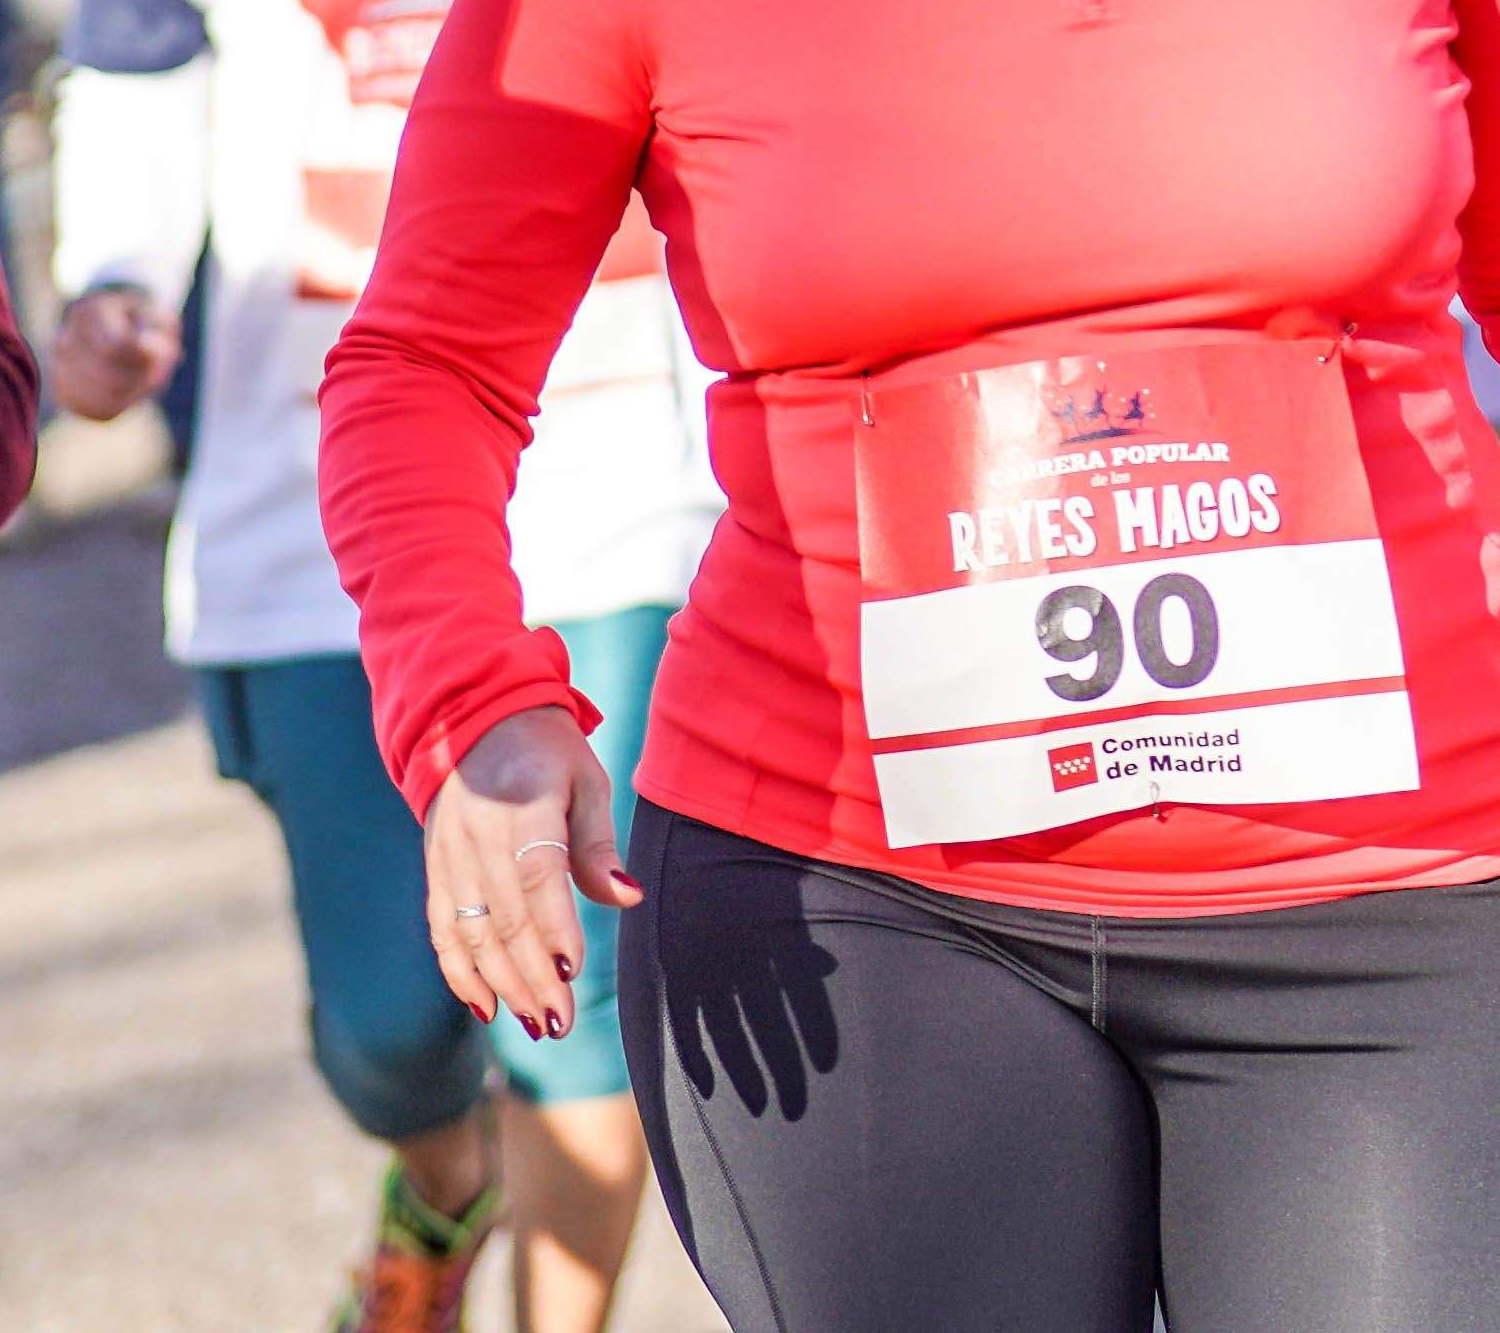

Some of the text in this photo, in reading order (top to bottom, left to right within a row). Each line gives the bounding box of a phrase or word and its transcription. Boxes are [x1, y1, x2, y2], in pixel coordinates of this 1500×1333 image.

[1111, 442, 1230, 466] POPULAR
[1090, 470, 1132, 488] de los
[947, 473, 1281, 573] REYES MAGOS
[1035, 571, 1221, 703] 90
[1101, 728, 1241, 755] Comunidad
[1106, 754, 1243, 780] de Madrid
